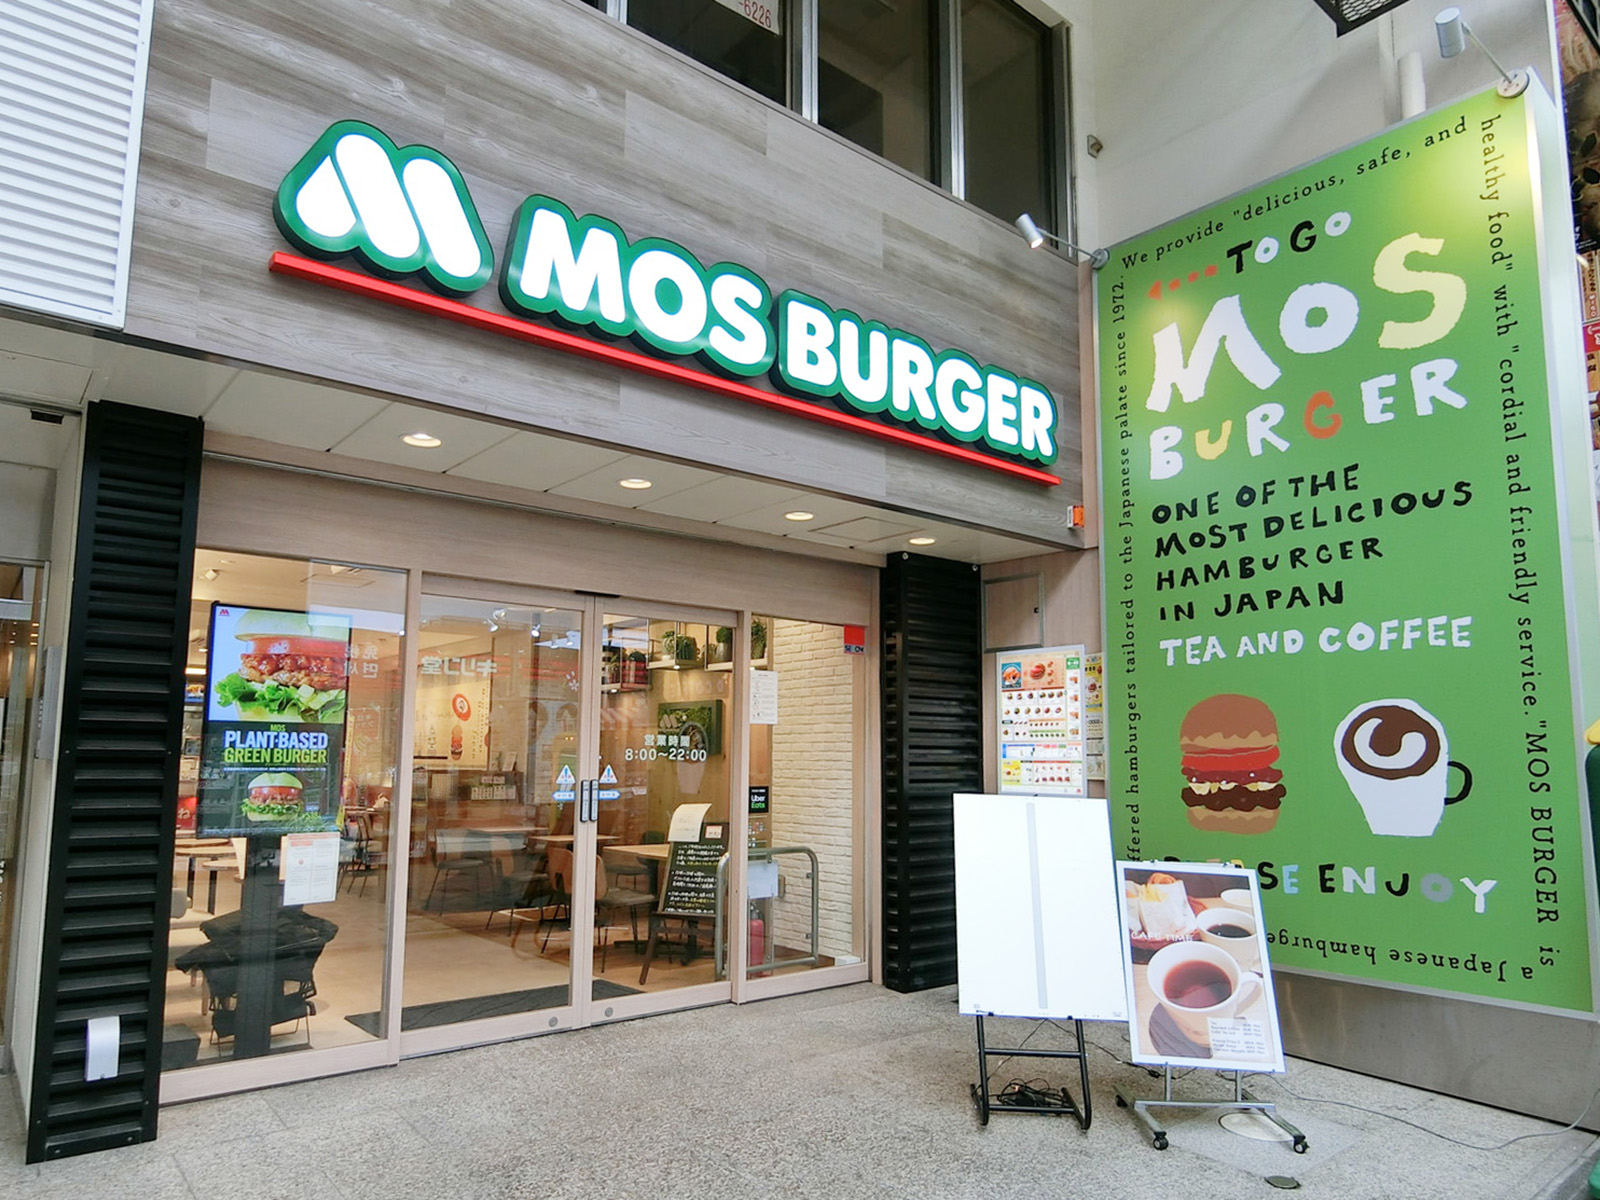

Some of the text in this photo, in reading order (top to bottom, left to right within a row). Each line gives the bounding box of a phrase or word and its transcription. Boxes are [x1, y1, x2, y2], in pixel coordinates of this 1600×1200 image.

[1424, 115, 1467, 147] and
[1356, 147, 1411, 175] safe,
[1479, 114, 1507, 201] healthy
[1233, 175, 1345, 221] "delicious,
[1121, 251, 1149, 270] We
[1155, 220, 1224, 260] provide
[1488, 211, 1513, 271] food"
[519, 207, 1054, 457] MOS BURGER
[1146, 232, 1468, 413] MOS
[1493, 284, 1519, 337] with
[1149, 358, 1468, 480] BURGER
[1152, 463, 1359, 524] ONE OF THE
[1506, 453, 1532, 495] and
[1154, 481, 1473, 558] MOST DELICIOUS
[1112, 275, 1141, 861] ffered hamburgers tailored to the Japanese palate since 1972.
[1156, 537, 1383, 591] HAMBURGER
[1508, 506, 1538, 605] friendly
[1160, 581, 1344, 622] IN JAPAN
[1159, 615, 1473, 667] TEA AND COFFEE
[270, 724, 286, 732] MOS
[644, 733, 691, 747] 営業時間
[223, 747, 327, 763] GREEN BURGER
[1318, 863, 1498, 914] ENJOY
[1530, 806, 1560, 924] BURGER
[1266, 928, 1377, 965] hamburge
[1389, 948, 1508, 982] Japanese
[1539, 945, 1561, 968] is
[1521, 966, 1534, 980] a
